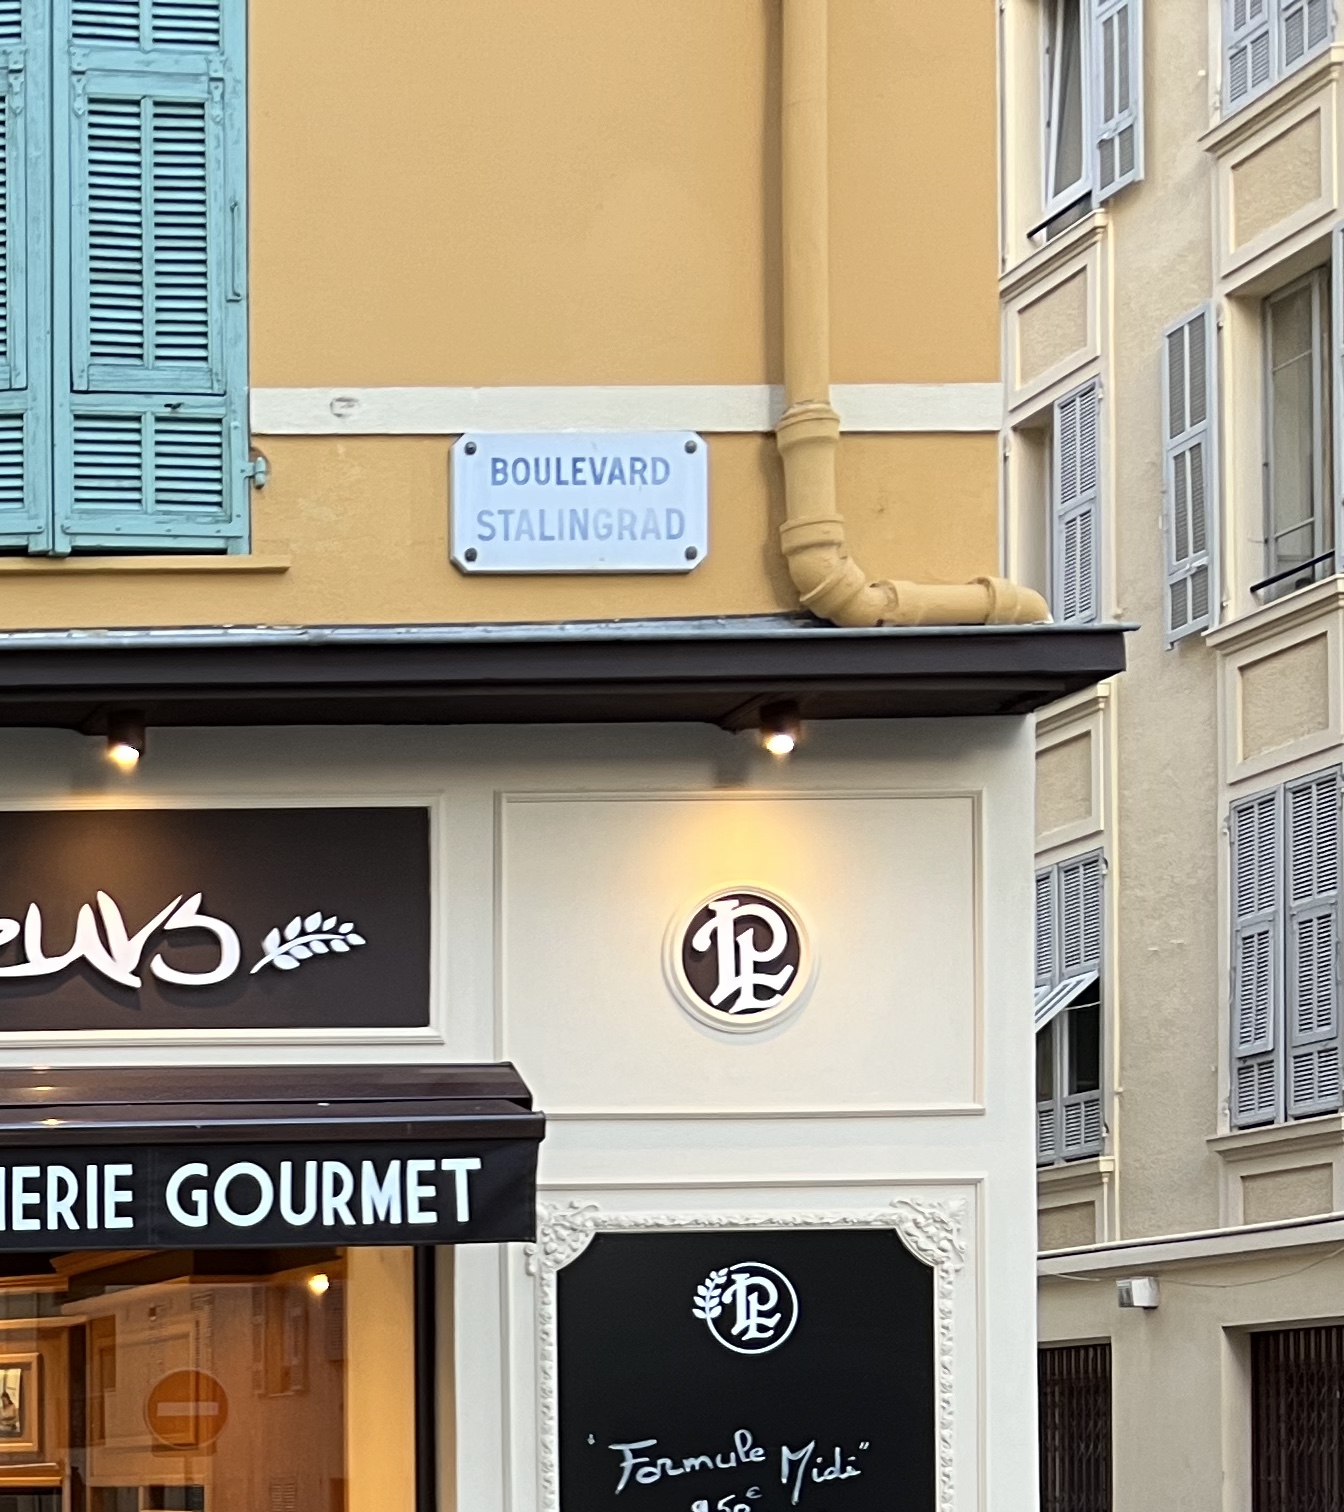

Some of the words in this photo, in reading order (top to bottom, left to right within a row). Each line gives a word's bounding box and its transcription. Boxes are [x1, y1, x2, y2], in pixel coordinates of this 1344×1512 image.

[490, 456, 670, 486] BOULEVARD
[476, 507, 686, 542] STALINGRAD
[164, 1156, 482, 1229] GOURMET
